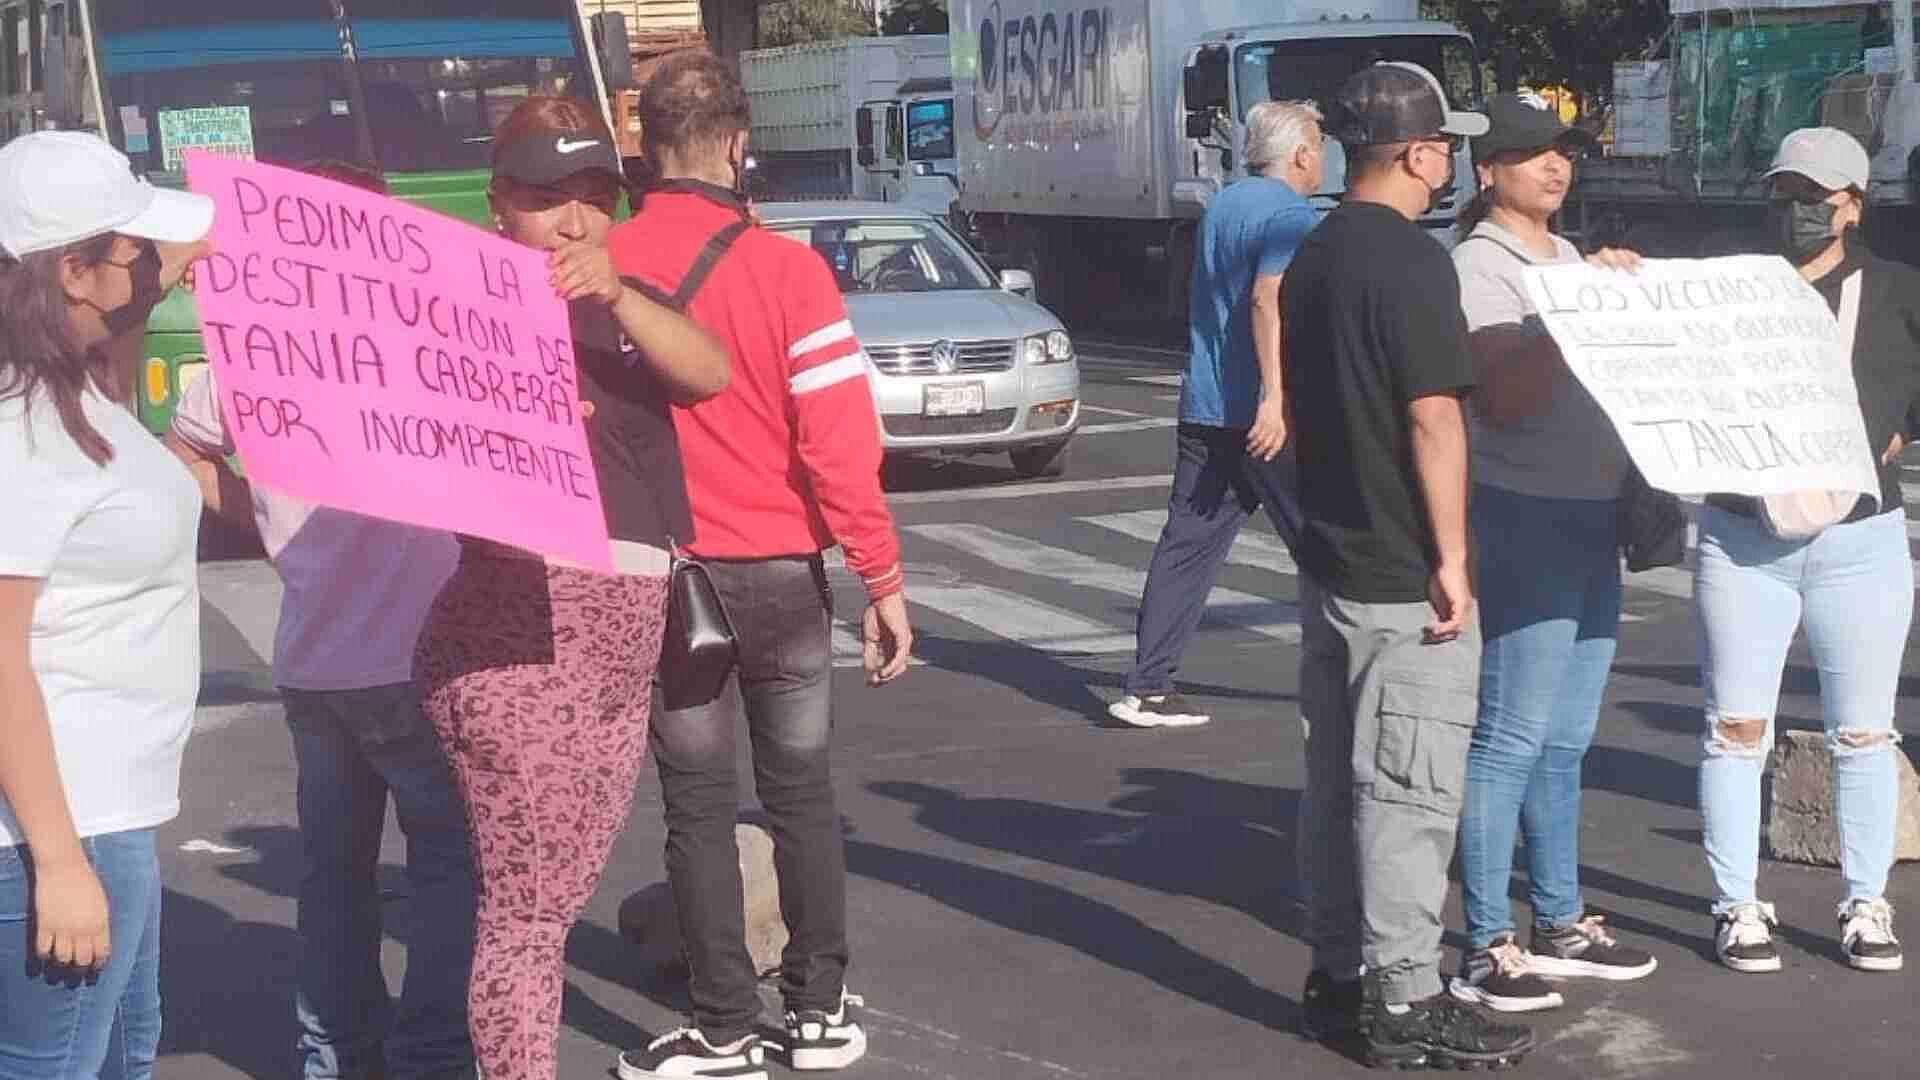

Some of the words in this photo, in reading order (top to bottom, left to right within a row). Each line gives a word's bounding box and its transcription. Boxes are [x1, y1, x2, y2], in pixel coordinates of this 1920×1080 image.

[233, 178, 431, 274] PEDIMOS
[478, 248, 523, 306] LA
[1538, 273, 1629, 314] LOS
[207, 251, 515, 358] DESTITUCION
[535, 334, 574, 386] DE
[205, 321, 386, 387] TANIA
[415, 345, 573, 426] CABRERA
[233, 390, 334, 462] POR
[360, 408, 593, 501] INCOMPETENTE
[1630, 420, 1801, 471] TANIA
